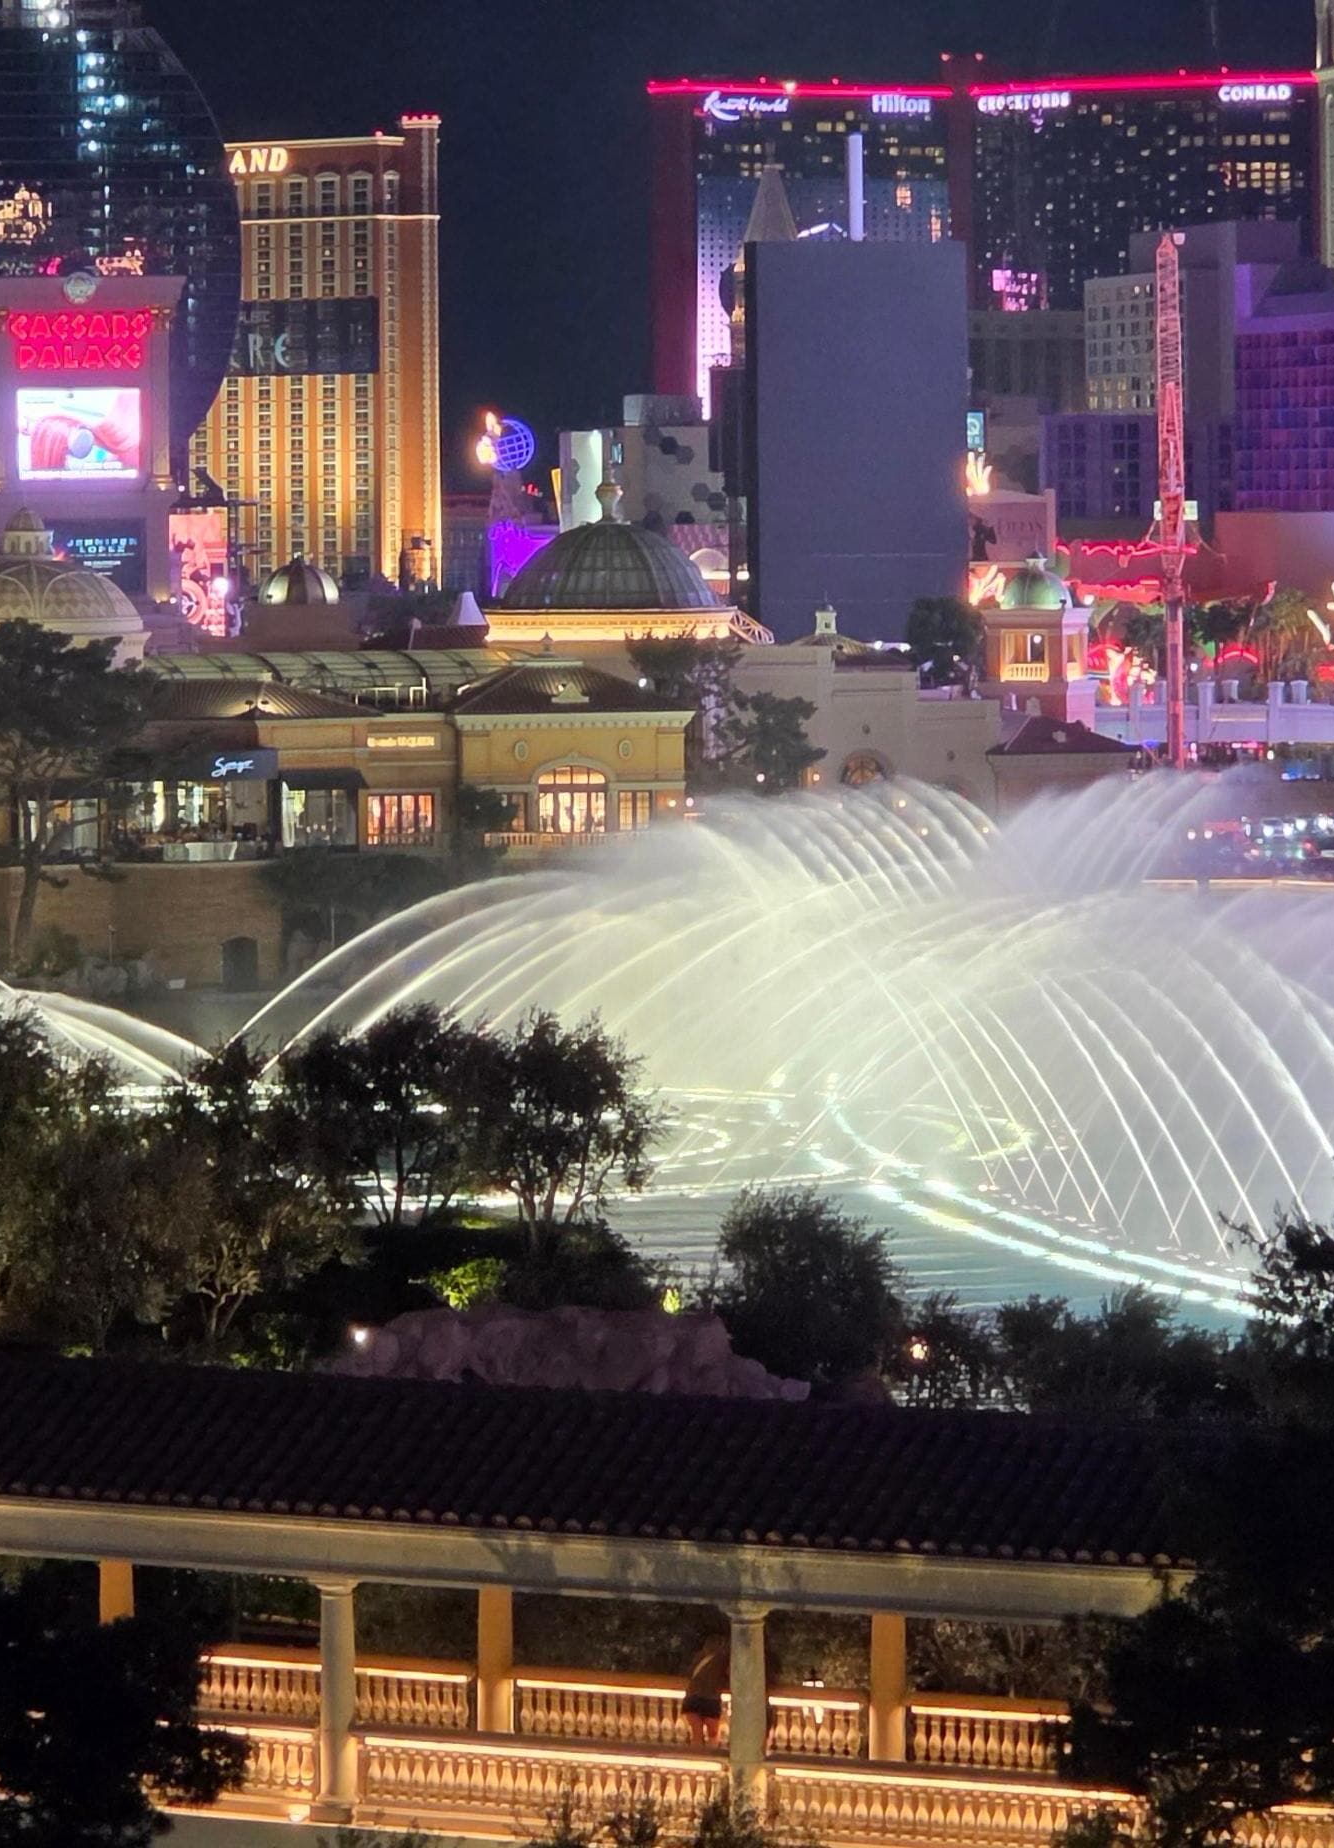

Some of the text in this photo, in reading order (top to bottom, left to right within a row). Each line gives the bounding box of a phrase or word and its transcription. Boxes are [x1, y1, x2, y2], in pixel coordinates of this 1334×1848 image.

[977, 92, 1070, 112] CROCKFORDS
[1218, 85, 1291, 101] CONRAD
[872, 95, 930, 113] Hilton
[10, 314, 148, 340] CAESARS
[19, 344, 141, 369] PALACE
[67, 537, 138, 547] JENNIFER
[79, 545, 126, 553] LOPEZ
